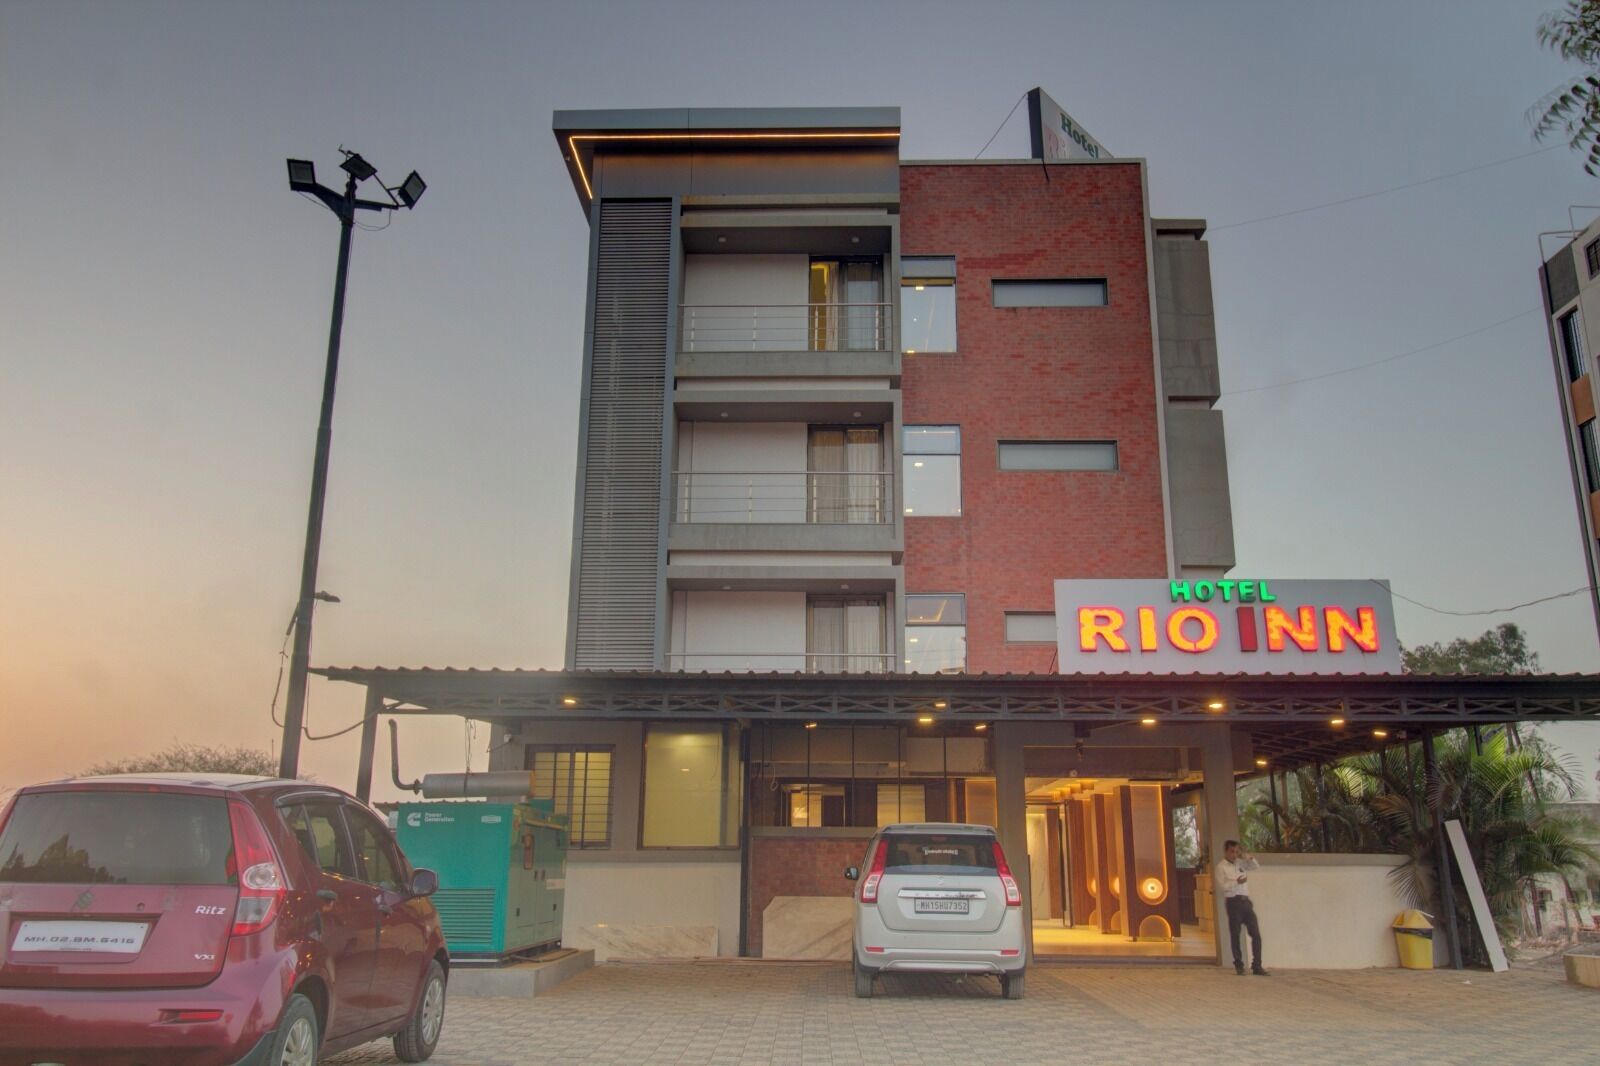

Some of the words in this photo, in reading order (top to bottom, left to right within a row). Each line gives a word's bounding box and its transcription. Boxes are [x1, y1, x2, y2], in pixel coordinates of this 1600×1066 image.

[1060, 112, 1099, 160] Hotel
[1170, 580, 1277, 602] HOTEL
[1077, 606, 1220, 653] RIO
[1237, 606, 1379, 652] INN
[194, 905, 226, 915] Ritz
